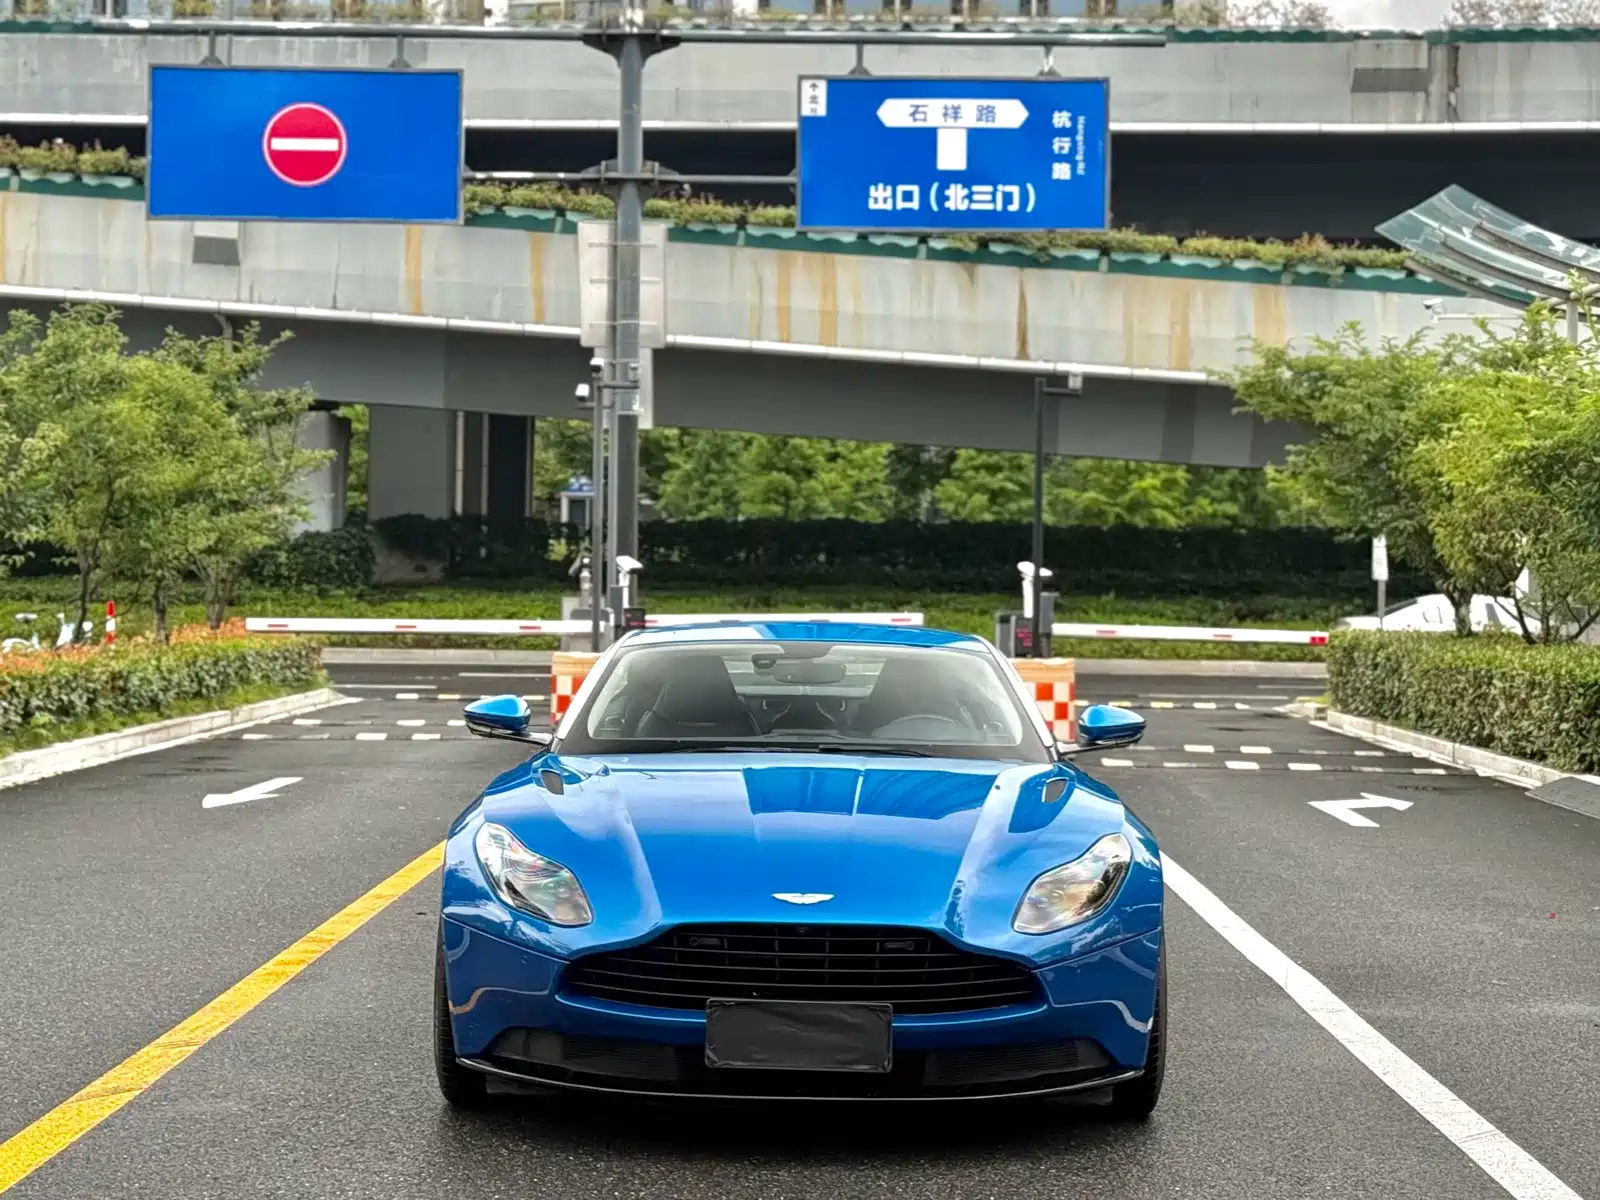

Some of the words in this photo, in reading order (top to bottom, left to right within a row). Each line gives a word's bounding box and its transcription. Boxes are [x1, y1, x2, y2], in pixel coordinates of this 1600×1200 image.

[909, 104, 996, 123] 石祥路
[1051, 110, 1072, 180] 杭行路
[868, 182, 1036, 212] 出口（北三门）
